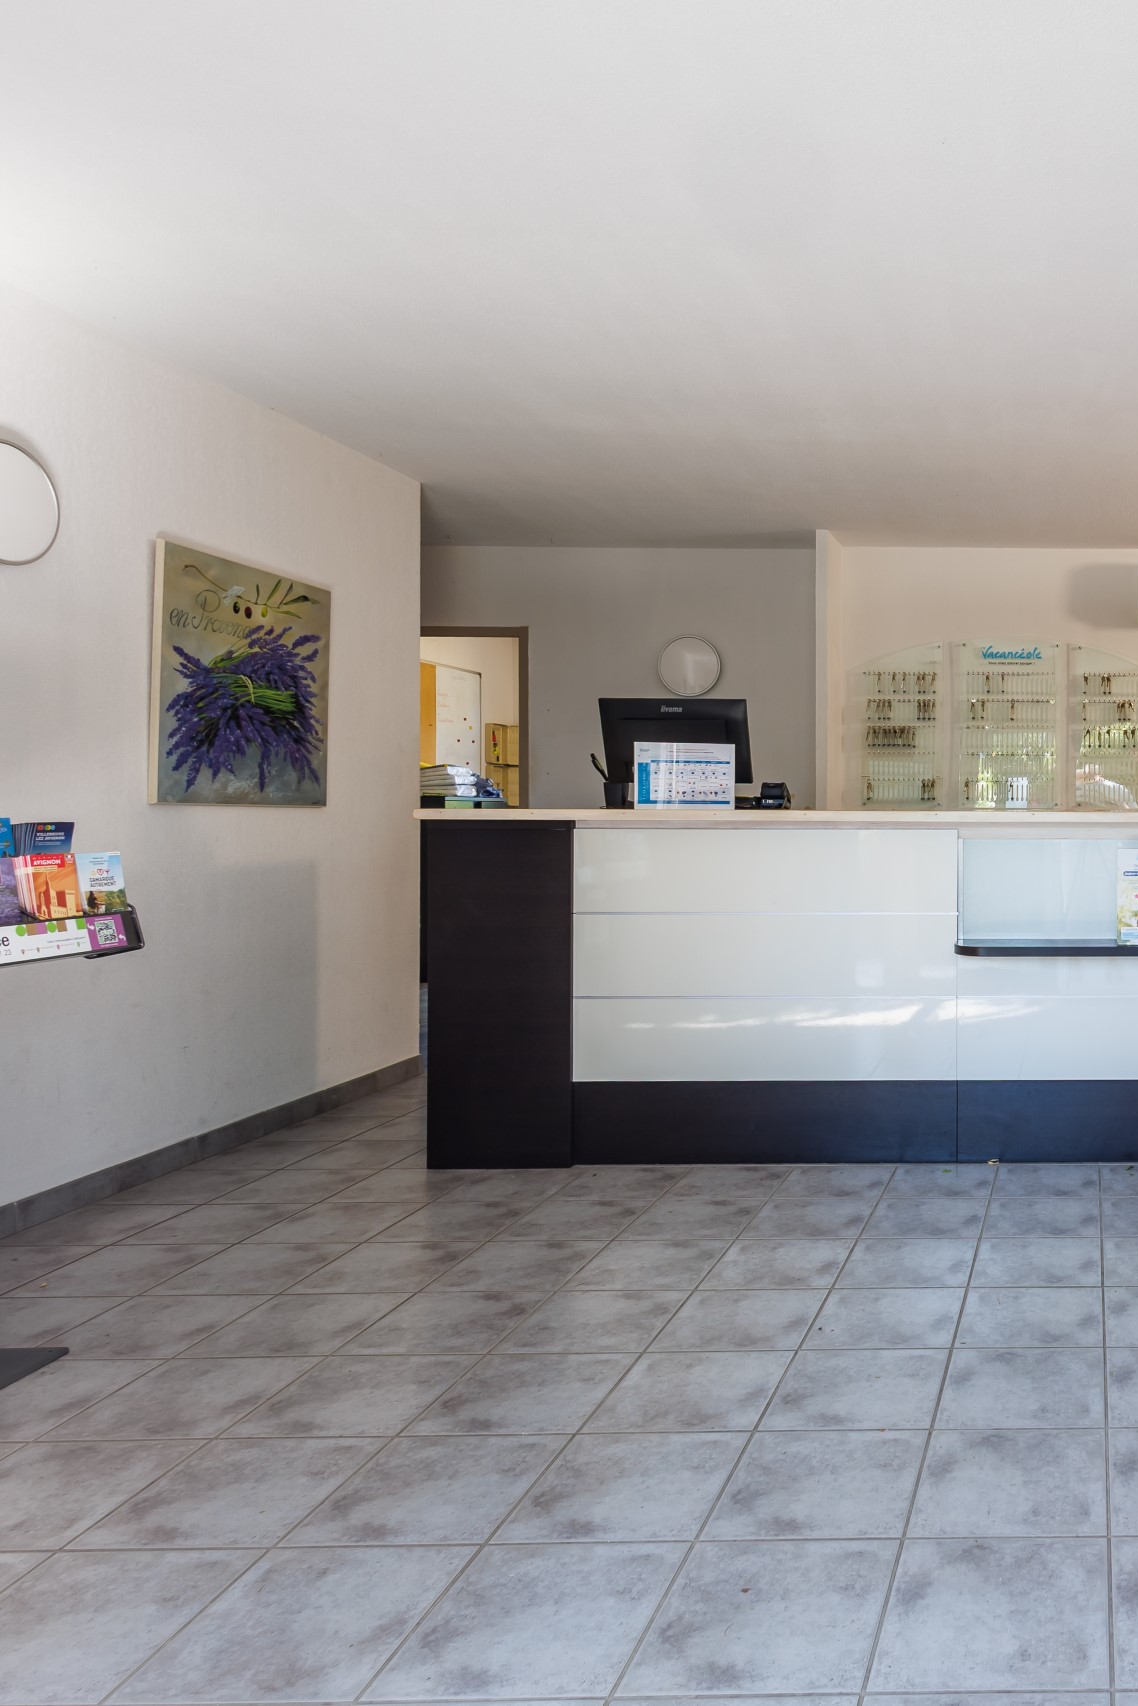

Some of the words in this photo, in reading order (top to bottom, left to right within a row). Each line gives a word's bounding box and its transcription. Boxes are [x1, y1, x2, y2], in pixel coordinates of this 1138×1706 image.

[169, 608, 190, 630] en
[982, 646, 1042, 659] Vacancéole
[660, 705, 683, 713] iiyama
